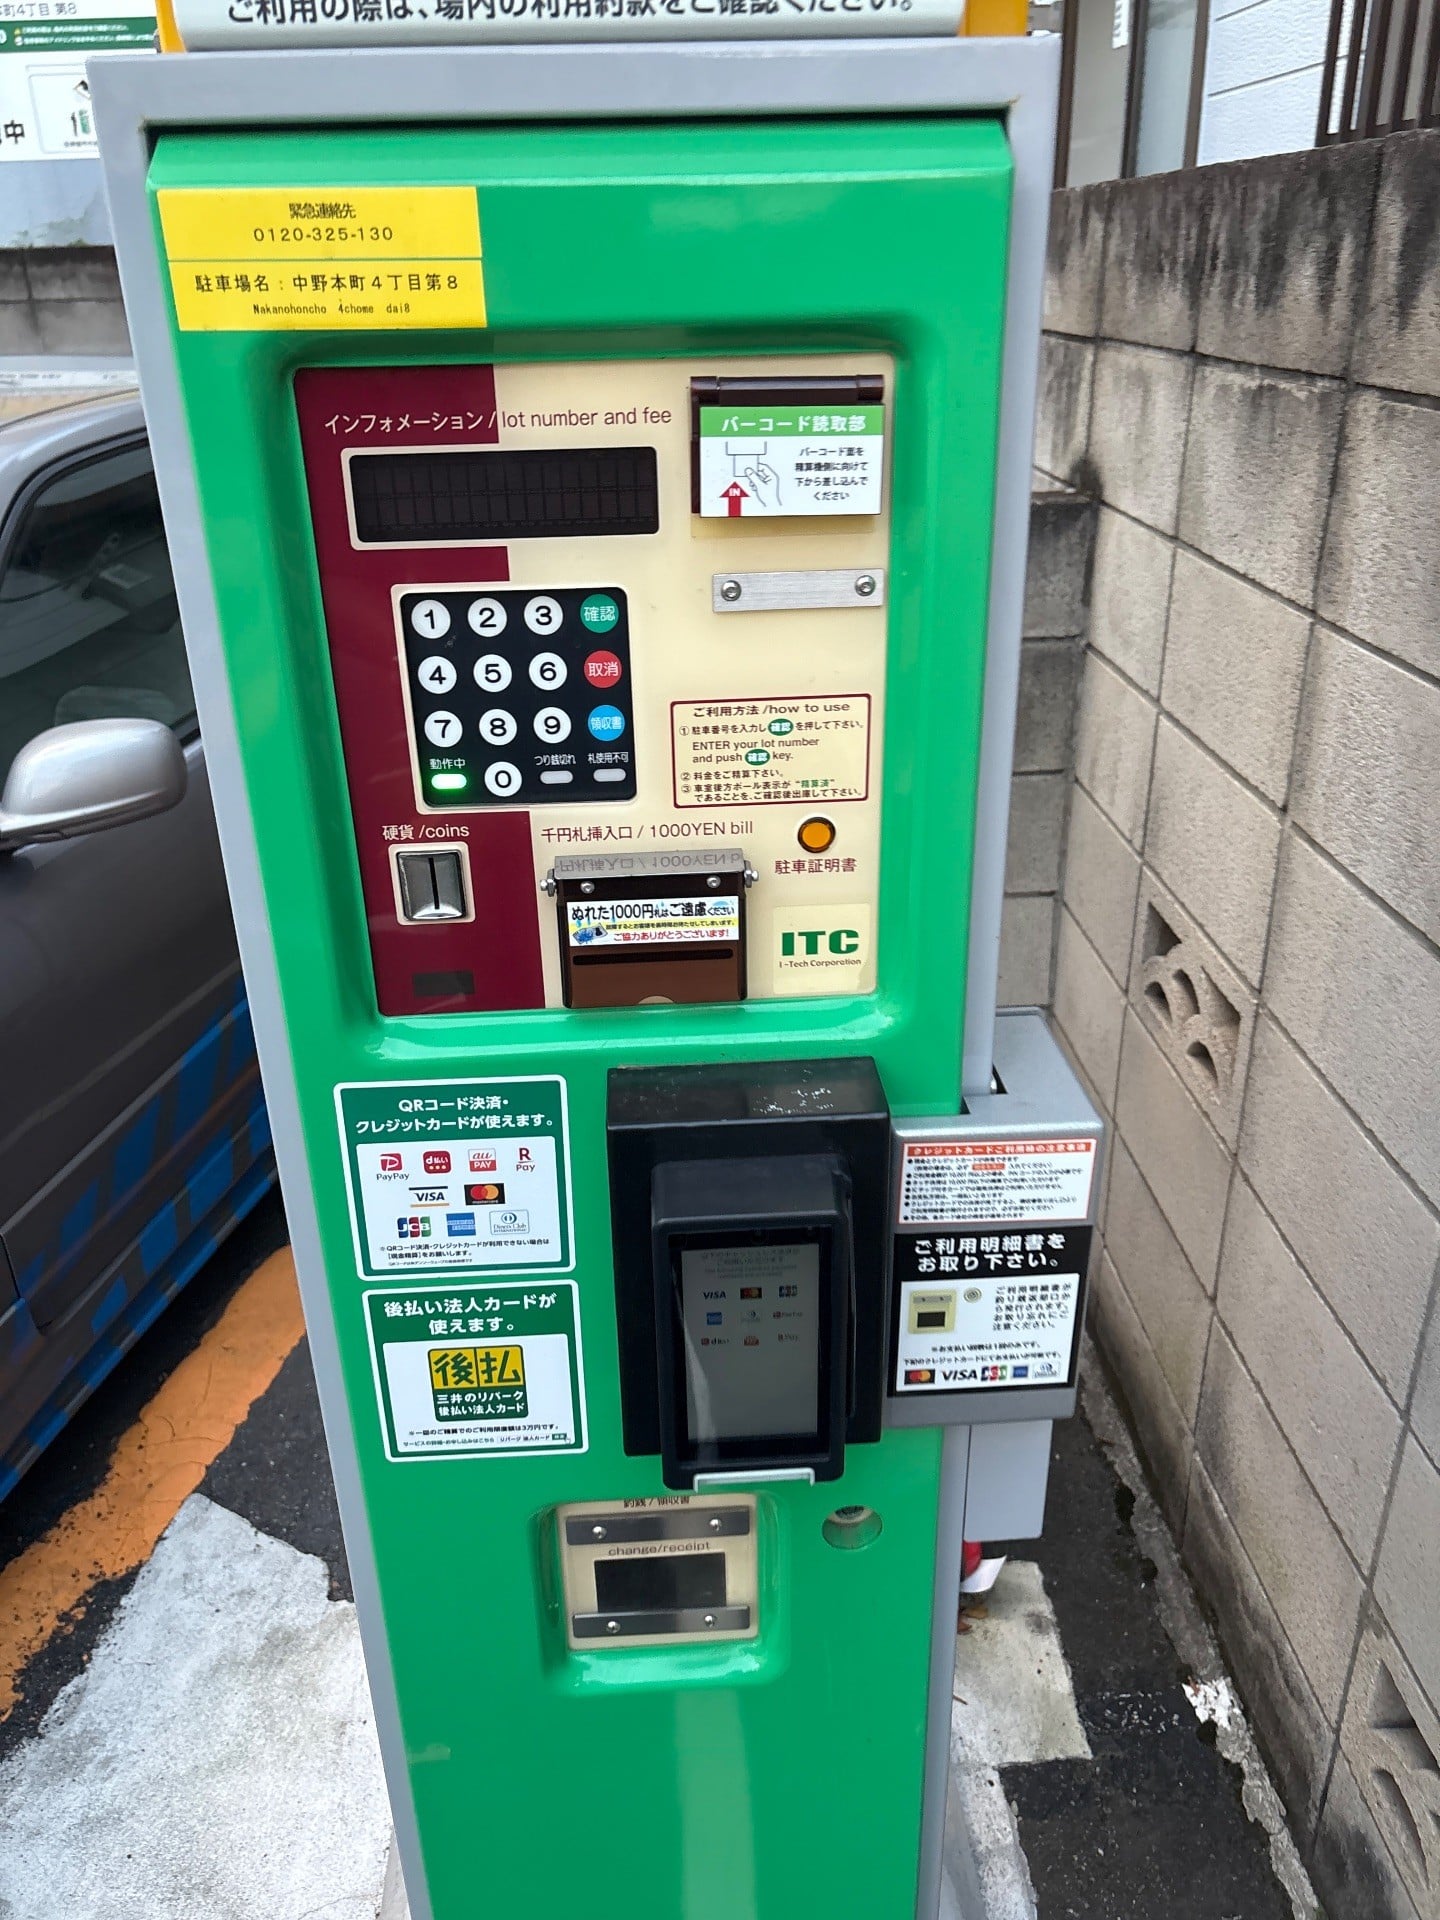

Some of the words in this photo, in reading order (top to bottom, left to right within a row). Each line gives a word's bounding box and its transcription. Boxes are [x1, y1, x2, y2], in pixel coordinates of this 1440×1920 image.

[0, 119, 25, 145] 中
[289, 203, 356, 219] 緊急連絡先
[254, 226, 393, 242] 0120-325-130
[253, 304, 326, 315] Nakanohoncho
[338, 303, 374, 314] 4chome
[387, 303, 410, 313] dai8
[502, 411, 525, 428] lot
[531, 410, 598, 427] number
[605, 408, 636, 425] and
[643, 406, 671, 424] fee
[722, 415, 866, 432] バーコード読取部
[794, 476, 869, 487] 下から差し込んで
[729, 487, 740, 497] IN
[813, 491, 850, 501] ください
[424, 609, 435, 629] 1
[479, 607, 496, 628] 2
[535, 605, 552, 625] 3
[584, 606, 616, 623] 確認
[429, 665, 446, 685] 4
[484, 664, 501, 683] 5
[539, 662, 557, 681] 6
[588, 662, 618, 677] 取消
[693, 706, 759, 718] ご利用方法
[805, 703, 819, 713] to
[823, 703, 850, 713] use
[434, 719, 451, 738] 7
[490, 718, 507, 736] 8
[544, 716, 561, 735] 9
[590, 716, 622, 731] 領収書
[692, 741, 730, 751] ENTER
[733, 740, 758, 752] your
[761, 739, 774, 748] lot
[778, 738, 819, 748] number
[429, 758, 466, 770] 動作中
[534, 754, 576, 766] つり銭切れ
[587, 752, 629, 764] 札使用不可
[692, 754, 712, 763] and
[716, 753, 742, 766] push
[772, 751, 794, 763] key.
[495, 770, 512, 788] 0
[382, 825, 414, 841] 硬貨
[541, 826, 632, 843] 千円札挿入口
[651, 822, 725, 839] 1000YEN
[731, 820, 753, 835] bill
[775, 858, 857, 874] 駐車証明書
[572, 901, 735, 921] ぬれた1000円札はご遠慮ください
[782, 929, 859, 956] ITC
[810, 958, 861, 968] Corporation
[356, 1113, 553, 1134] クレジットカードが使えます。
[472, 1151, 492, 1160] au
[519, 1147, 531, 1161] R
[474, 1161, 491, 1169] PAY
[516, 1164, 535, 1172] Pay
[376, 1172, 410, 1181] PayPay
[411, 1191, 445, 1202] VISA
[914, 1233, 1066, 1256] ご利用明細書を
[918, 1253, 1059, 1273] お取り下さい。
[703, 1290, 727, 1300] VISA
[384, 1293, 557, 1318] 後払い法人カードが
[429, 1317, 514, 1335] 使えます。
[433, 1350, 521, 1386] 後払
[942, 1369, 977, 1381] VISA
[437, 1391, 524, 1405] 三井のリパーク
[438, 1402, 524, 1417] 後払い法人カード
